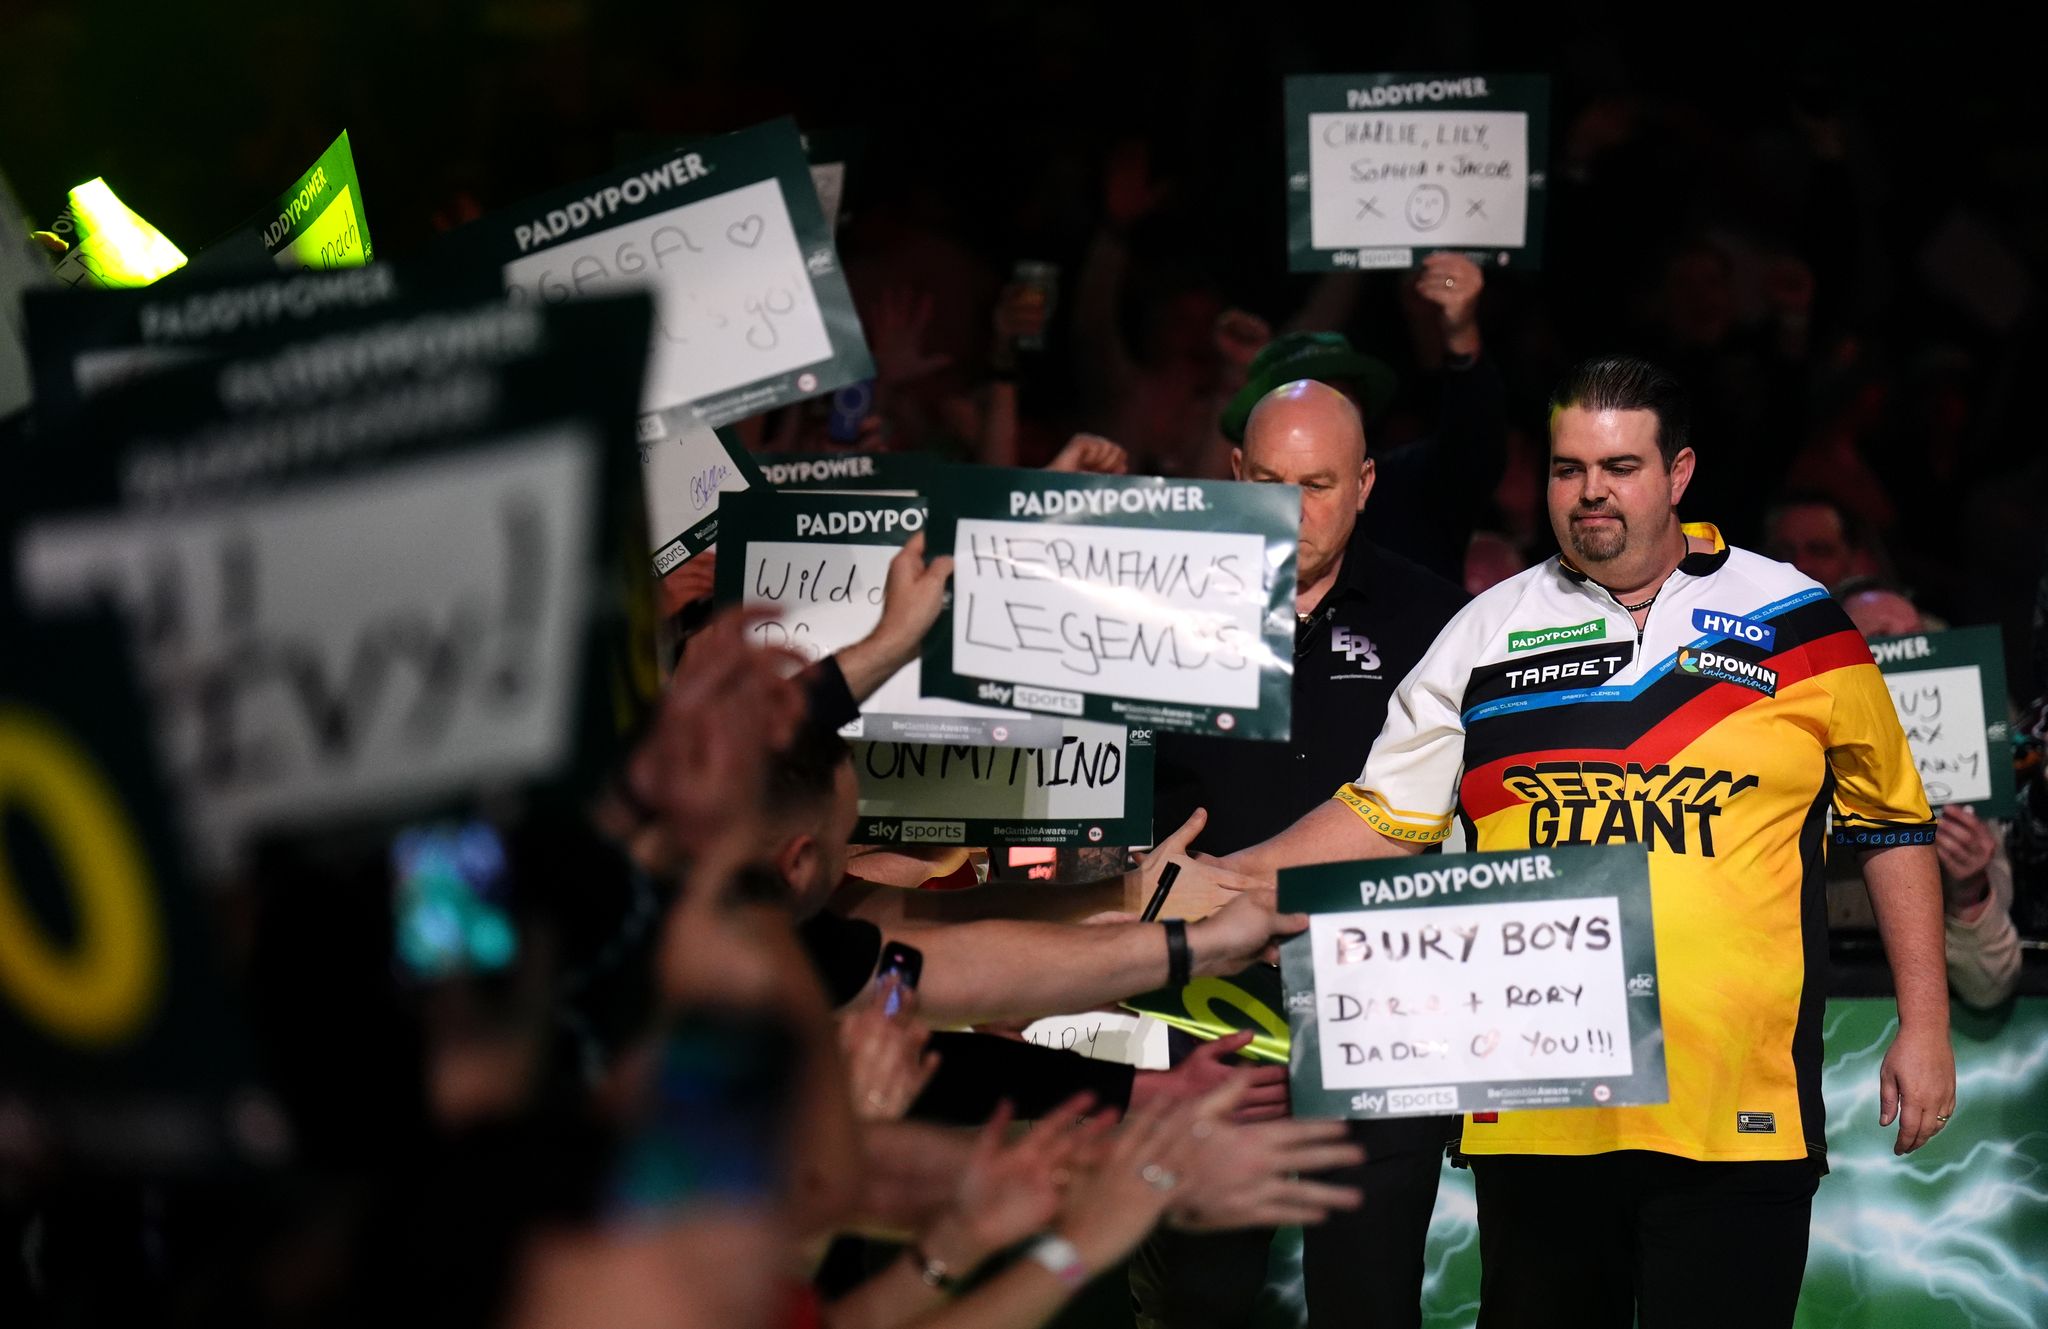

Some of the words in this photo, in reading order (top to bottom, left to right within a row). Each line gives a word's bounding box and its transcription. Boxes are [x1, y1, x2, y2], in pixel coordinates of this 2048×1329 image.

[1347, 77, 1487, 109] PADDYPOWER
[263, 166, 328, 249] ADDYPOWER
[514, 152, 708, 251] PADDYPOWER
[1010, 487, 1206, 517] PADDYPOWER
[797, 508, 931, 537] PADDYPO
[656, 544, 686, 570] sports
[1331, 626, 1381, 671] EPS
[1511, 624, 1598, 649] PADDYPOWER
[1505, 656, 1622, 689] TARGET
[1702, 667, 1774, 695] international
[978, 682, 1013, 706] sky
[1018, 688, 1078, 711] sports
[1008, 735, 1122, 789] MIND
[1502, 761, 1759, 805] GERMAN
[868, 821, 899, 840] sky
[905, 823, 962, 842] sports
[1528, 799, 1723, 858] GIANT
[1360, 855, 1555, 906] PADDYPOWER
[1336, 922, 1480, 966] BURY
[1502, 916, 1612, 957] BOYS
[1506, 984, 1583, 1010] RORY
[1521, 1029, 1614, 1057] YOU!!!
[1350, 1090, 1387, 1113] sky
[1391, 1091, 1454, 1110] sports
